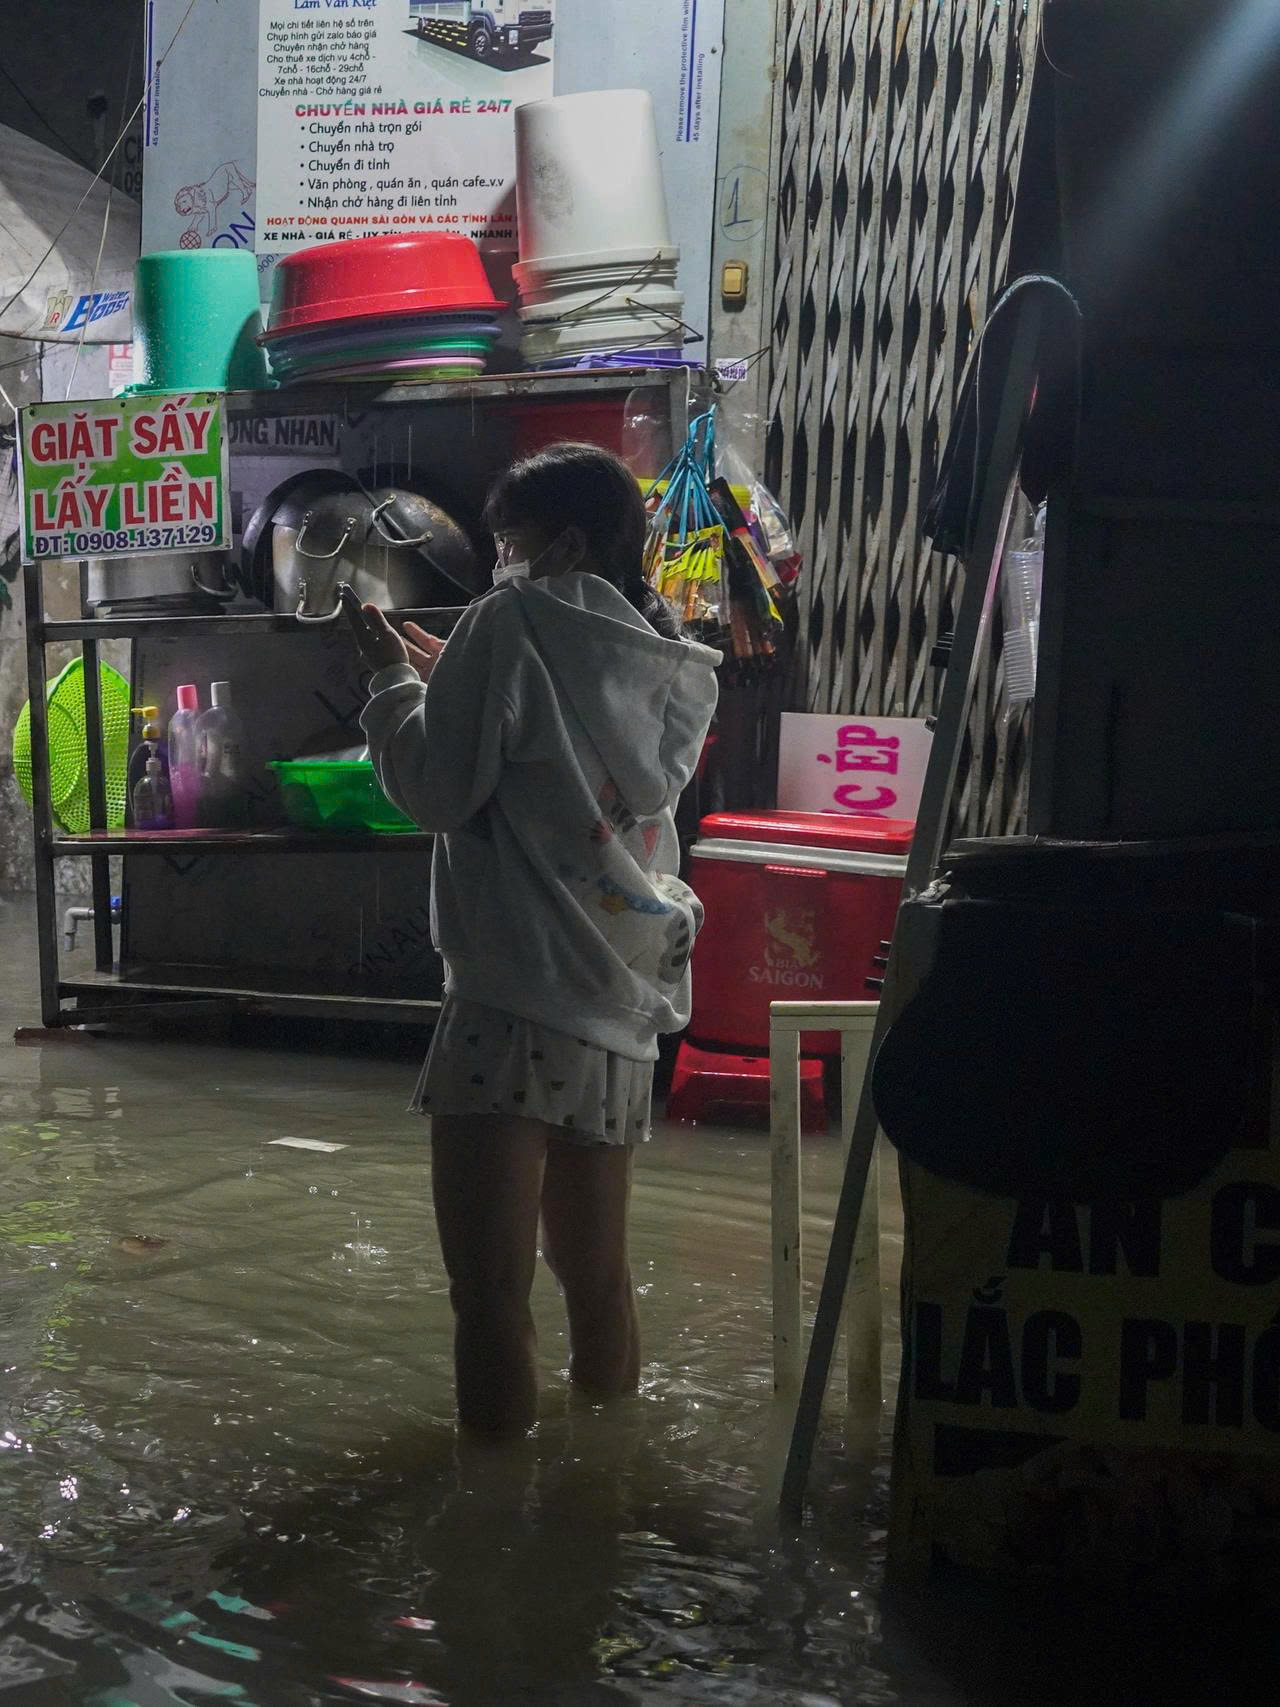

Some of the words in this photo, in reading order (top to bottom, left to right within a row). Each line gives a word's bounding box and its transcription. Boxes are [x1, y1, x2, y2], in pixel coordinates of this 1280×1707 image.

[270, 22, 284, 31] Mọi
[301, 19, 314, 29] tiết
[316, 20, 330, 28] liên
[333, 20, 343, 29] hệ
[346, 18, 356, 28] số
[358, 19, 374, 27] trên
[267, 32, 288, 42] Chụp
[327, 31, 344, 39] zalo
[346, 30, 362, 38] báo
[364, 30, 377, 40] giá
[307, 42, 328, 51] nhận
[348, 41, 369, 52] hàng
[267, 54, 283, 63] Cho
[286, 54, 304, 62] thuê
[318, 54, 335, 63] dịch
[337, 54, 347, 62] vụ
[696, 53, 705, 90] installing
[274, 77, 286, 85] Xe
[288, 76, 303, 85] nhà
[306, 76, 324, 86] hoạt
[326, 75, 346, 86] động
[348, 75, 367, 84] 24/7
[676, 117, 684, 142] Please
[680, 33, 688, 71] protective
[259, 86, 290, 98] Chuyển
[292, 88, 308, 96] nhà
[336, 86, 356, 96] hàng
[359, 86, 371, 96] giá
[295, 98, 366, 117] CHUYỂN
[372, 98, 408, 115] NHÀ
[414, 97, 444, 114] GIÁ
[477, 98, 512, 114] 24/7
[309, 121, 350, 136] Chuyển
[355, 122, 375, 133] nhà
[379, 123, 402, 134] trọn
[405, 121, 422, 136] gói
[693, 111, 702, 130] days
[693, 132, 700, 142] 45
[309, 139, 351, 155] Chuyển
[355, 140, 375, 152] nhà
[378, 141, 394, 153] trọ
[308, 158, 350, 174] Chuyển
[353, 159, 364, 171] đi
[368, 158, 390, 170] tỉnh
[308, 178, 329, 190] Văn
[333, 178, 367, 192] phòng
[376, 177, 404, 192] quán
[407, 178, 421, 188] ăn
[431, 176, 458, 191] quán
[308, 196, 338, 210] Nhận
[342, 196, 363, 208] chở
[368, 196, 394, 210] hàng
[397, 196, 407, 207] đi
[411, 195, 431, 206] liên
[434, 195, 457, 206] tỉnh
[331, 216, 368, 226] QUANH
[372, 214, 389, 224] SÀI
[393, 214, 416, 224] GÒN
[419, 214, 433, 224] VÀ
[437, 213, 459, 223] CÁC
[264, 232, 278, 241] XE
[281, 230, 305, 240] NHÀ
[316, 229, 335, 240] GIÁ
[470, 230, 512, 239] NHANH
[103, 290, 130, 302] Water
[60, 294, 130, 332] Boost
[30, 413, 119, 470] GIẶT
[132, 398, 213, 456] SẤY
[34, 477, 110, 531] LẤY
[124, 466, 214, 525] LIỀN
[36, 536, 68, 555] ĐT:
[75, 526, 215, 552] 0908.137129
[816, 725, 900, 774] ÉP
[748, 966, 824, 989] SAIGON
